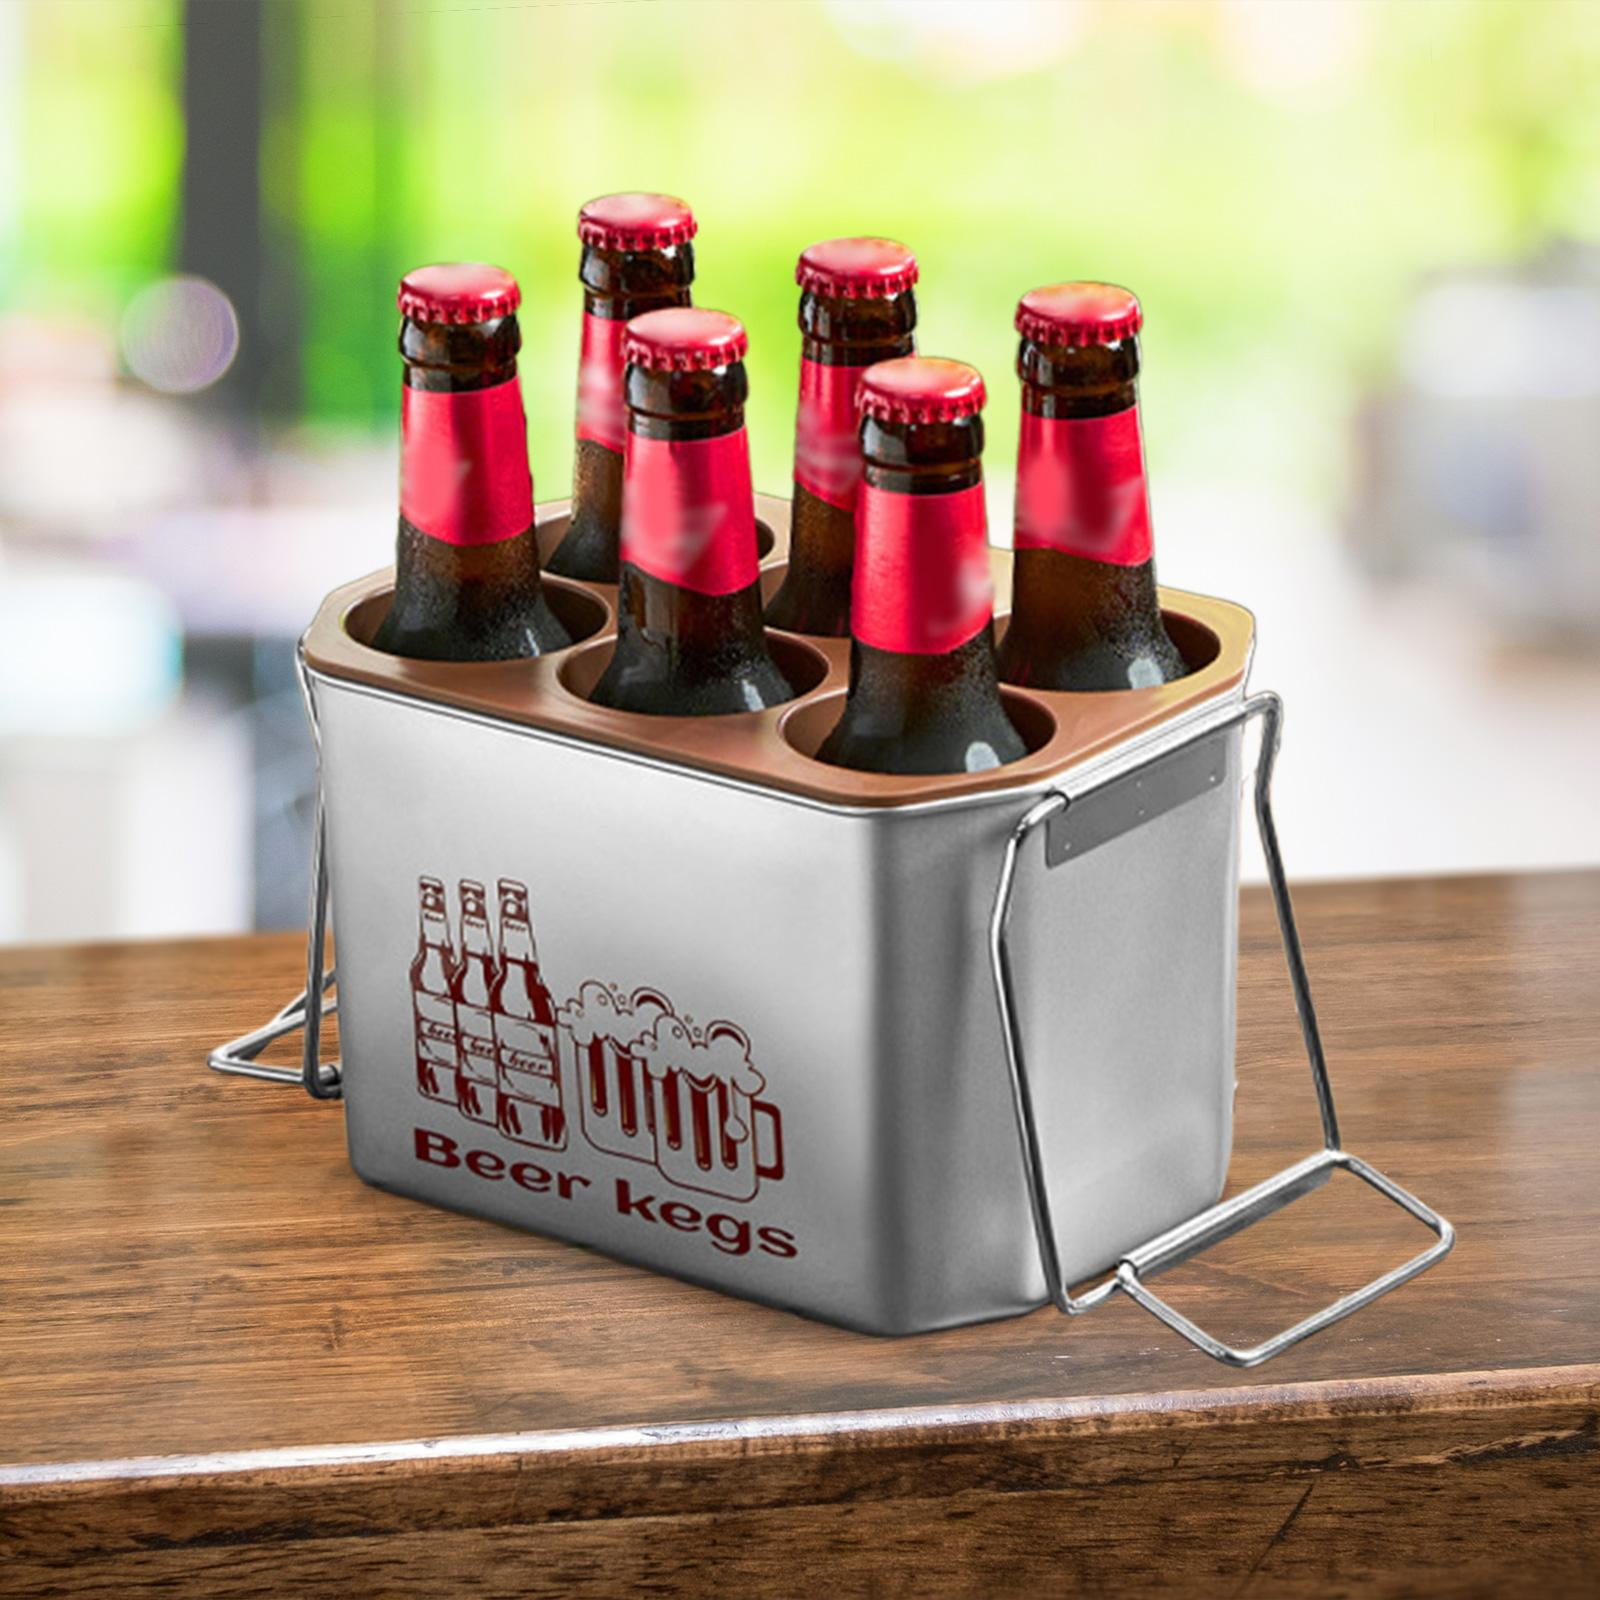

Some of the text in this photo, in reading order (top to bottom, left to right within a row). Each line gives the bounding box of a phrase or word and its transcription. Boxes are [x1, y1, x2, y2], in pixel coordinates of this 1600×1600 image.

[427, 1022, 456, 1040] bee
[509, 1051, 547, 1072] beer
[413, 1128, 799, 1258] Beer kegs
